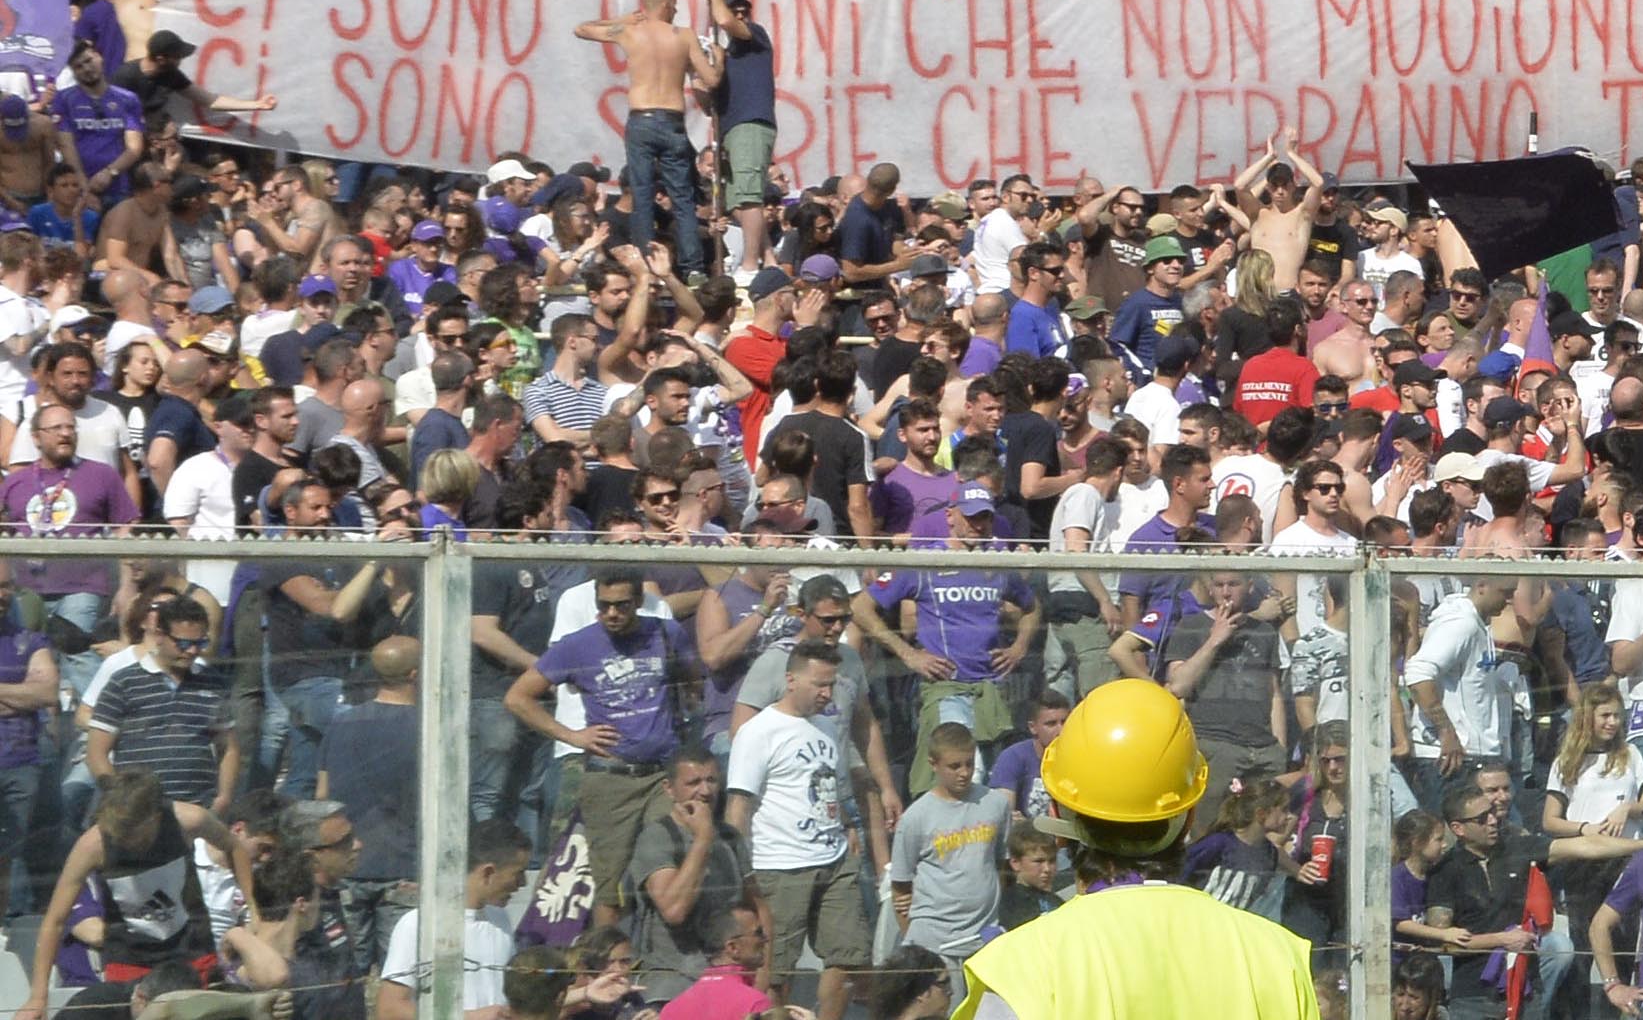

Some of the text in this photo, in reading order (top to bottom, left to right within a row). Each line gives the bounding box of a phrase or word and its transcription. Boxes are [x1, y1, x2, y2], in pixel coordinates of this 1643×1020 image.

[323, 51, 537, 166] SONO
[931, 82, 1089, 193] CHE
[797, 739, 836, 765] TIPI
